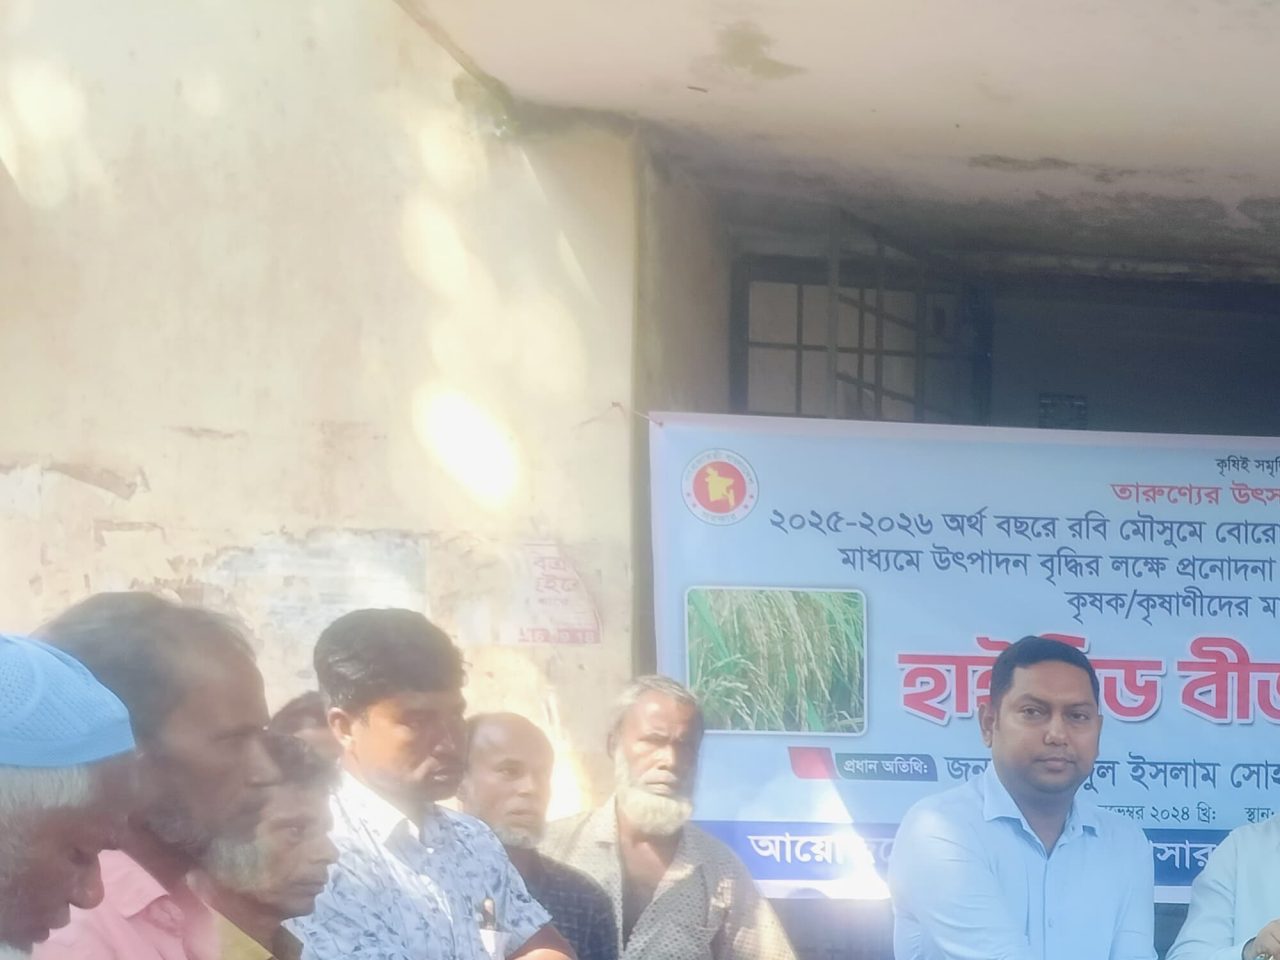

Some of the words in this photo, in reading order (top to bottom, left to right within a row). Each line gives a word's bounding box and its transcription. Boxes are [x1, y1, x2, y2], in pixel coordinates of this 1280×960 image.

[1215, 455, 1250, 477] কৃষিই
[1109, 481, 1222, 506] তারুণ্যের
[769, 508, 933, 538] ২০২৫-২০২৬
[941, 506, 988, 538] অর্থ
[993, 515, 1060, 541] বছরে
[1066, 510, 1111, 541] রবি
[1119, 510, 1207, 549] মৌসুমে
[838, 546, 924, 573] মাধ্যমে
[929, 543, 1031, 576] উৎপাদন
[1037, 546, 1103, 586] বৃদ্ধির
[1109, 555, 1169, 579] লক্ষে
[1176, 555, 1276, 582] প্রনোদনা
[1064, 585, 1252, 626] কৃষক/কৃষাণীদের
[843, 758, 879, 774] প্রধান
[1127, 751, 1221, 792] ইসলাম
[1150, 804, 1190, 823] ২০২৪
